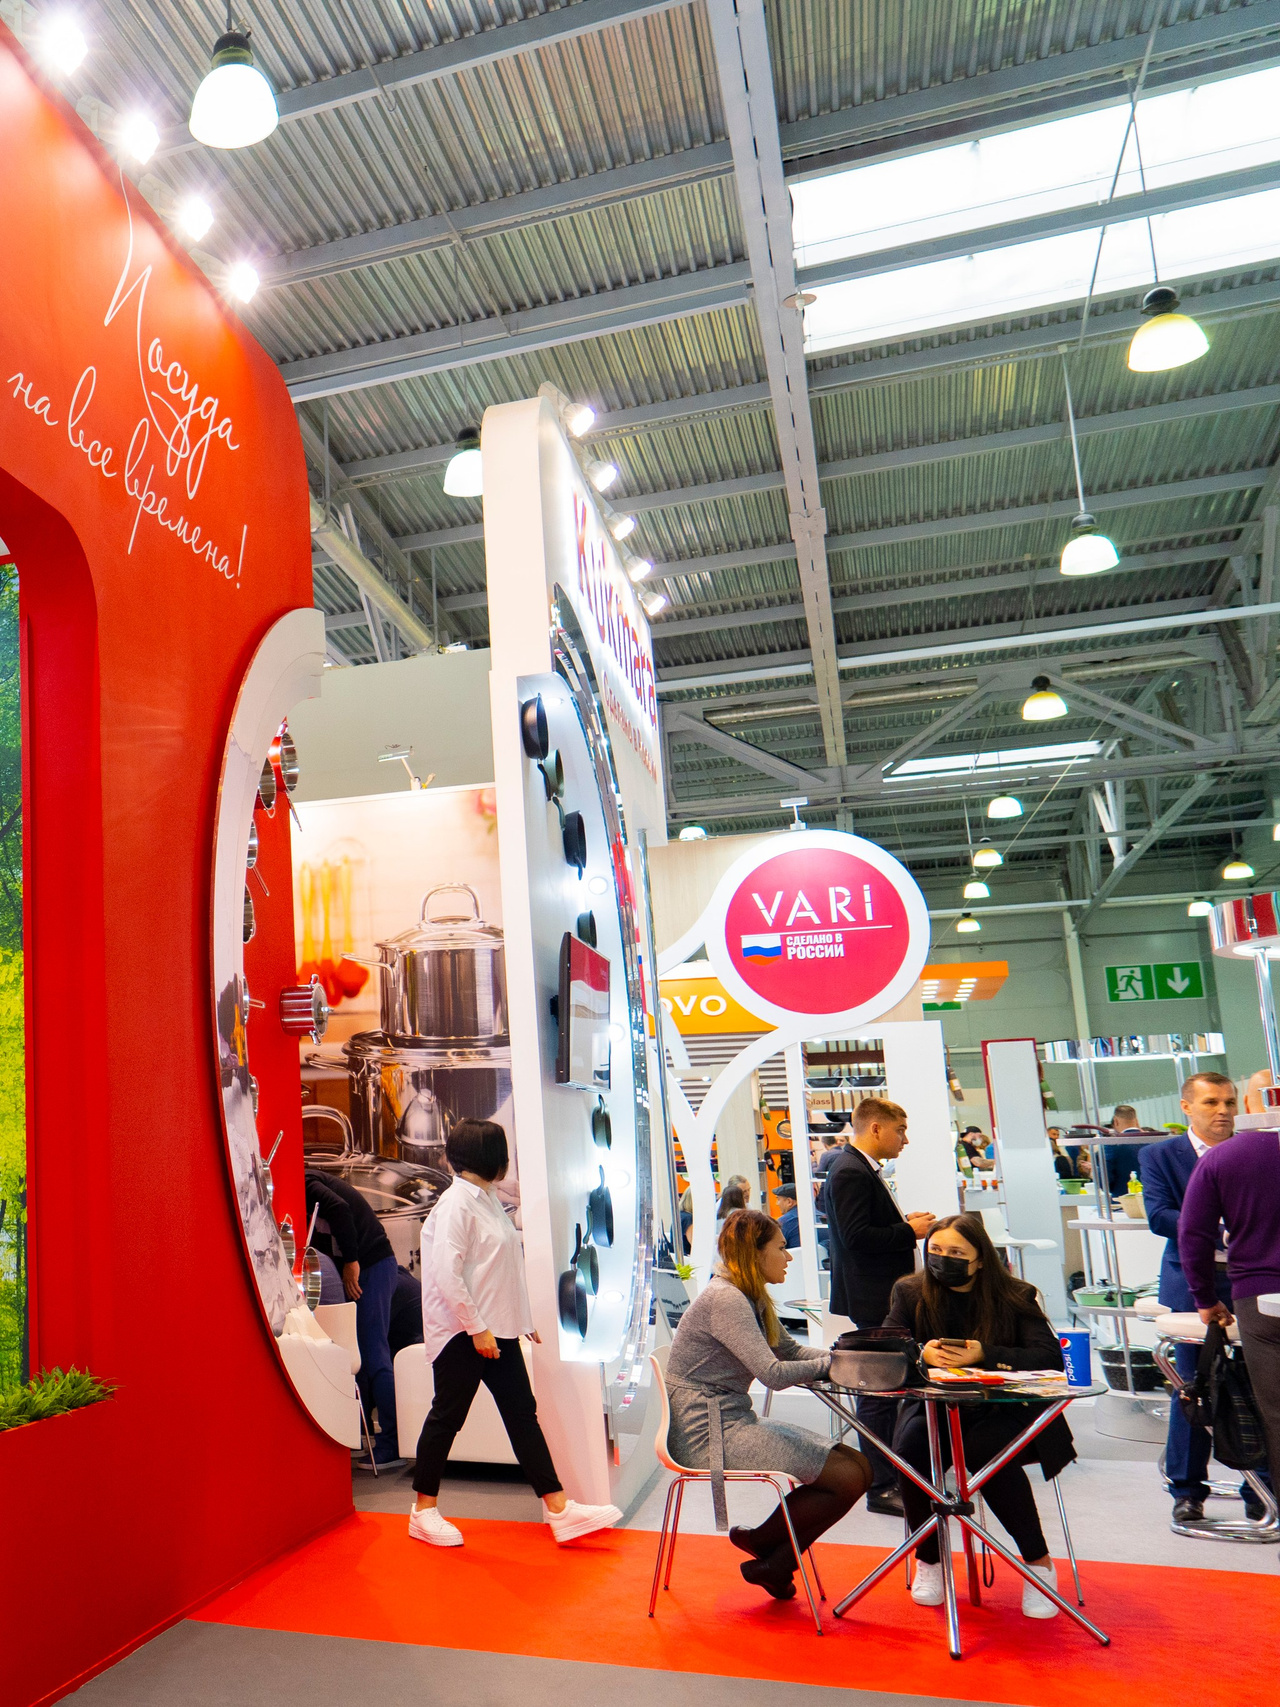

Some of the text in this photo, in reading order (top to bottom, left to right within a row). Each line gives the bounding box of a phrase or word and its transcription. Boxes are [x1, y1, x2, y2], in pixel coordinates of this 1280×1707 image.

[105, 166, 240, 500] Посуда
[7, 372, 58, 426] на
[124, 417, 247, 589] времена!
[573, 491, 657, 731] Kukmara
[786, 933, 843, 947] СДЕЛАНО В
[787, 944, 845, 960] РОССИИ
[810, 1098, 831, 1106] lass
[1064, 1354, 1077, 1381] pepsi
